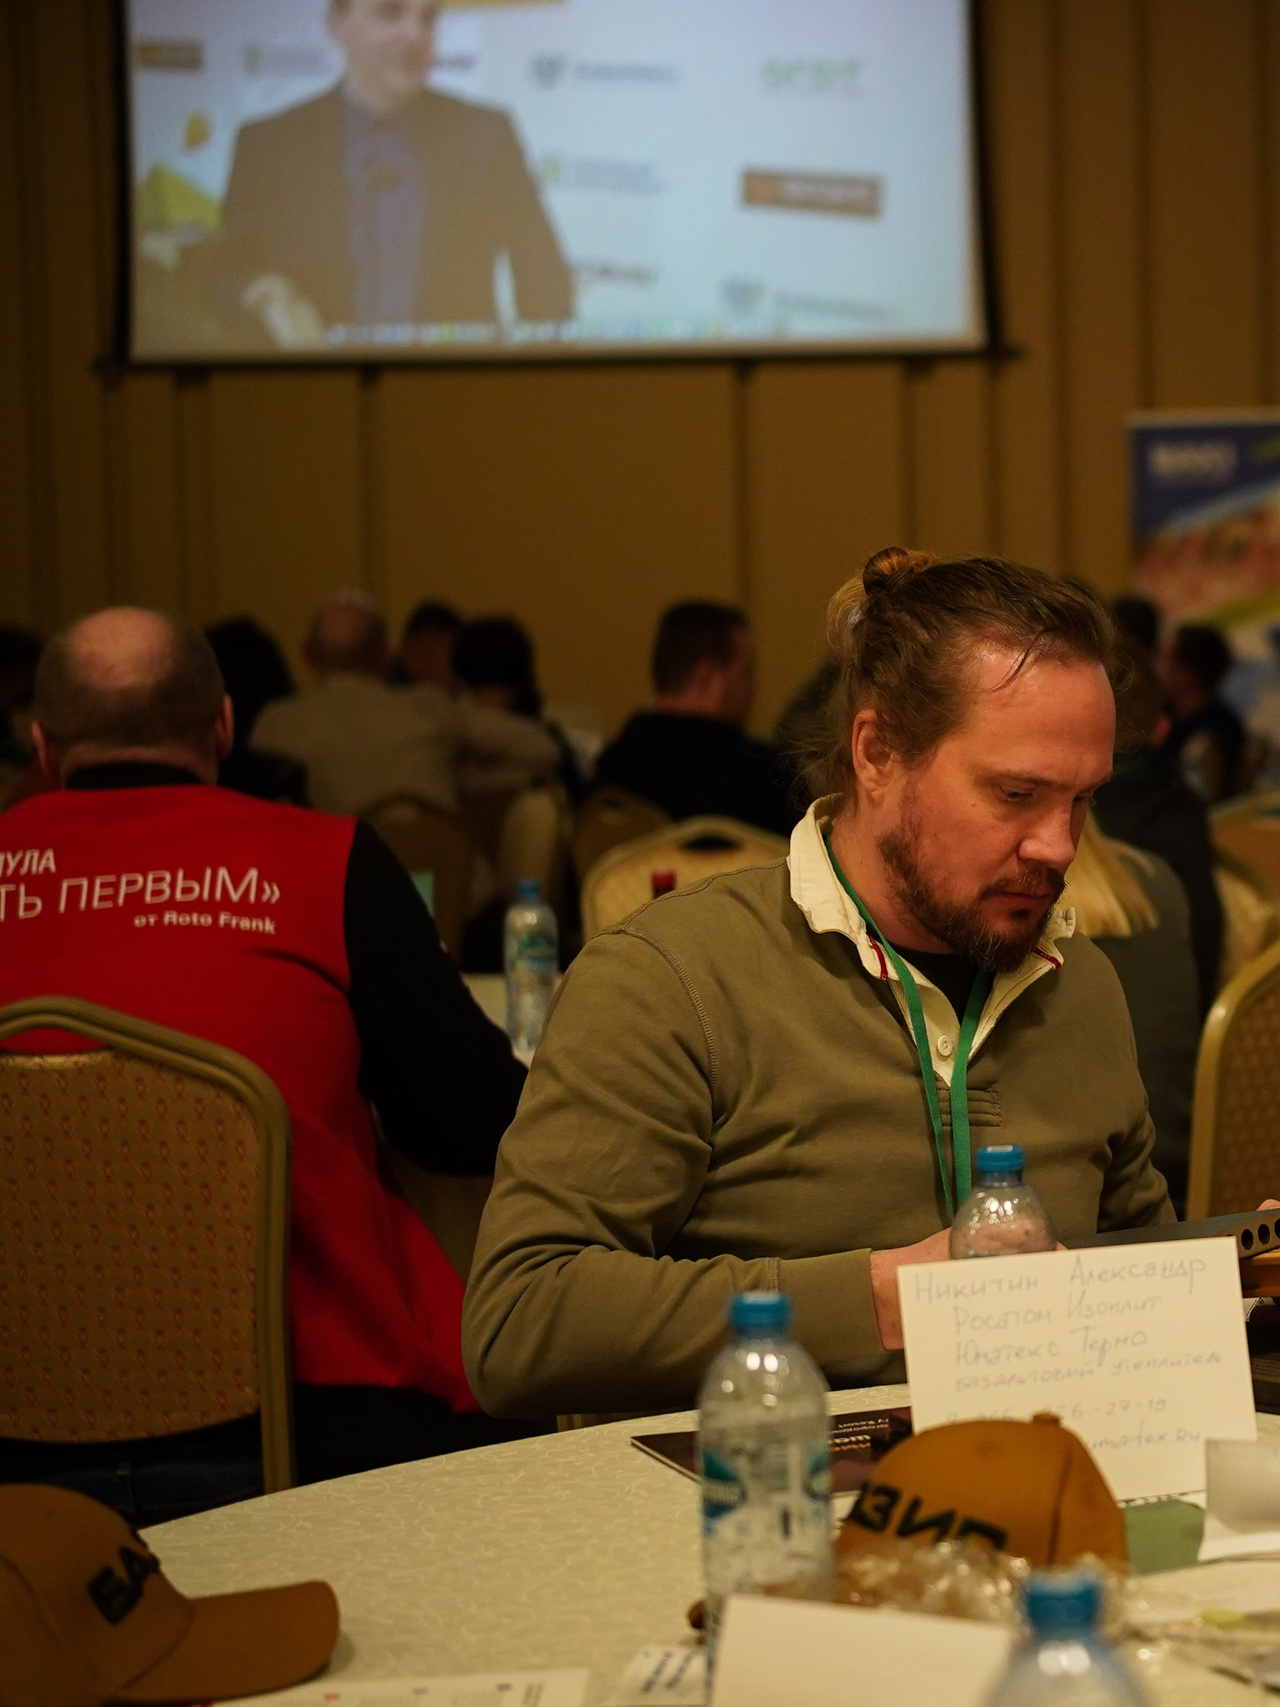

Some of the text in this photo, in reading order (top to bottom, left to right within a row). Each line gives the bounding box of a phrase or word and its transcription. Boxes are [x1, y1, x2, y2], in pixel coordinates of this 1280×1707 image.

[59, 866, 281, 914] ПЕРВЫМ»
[163, 910, 213, 927] Roto
[218, 911, 276, 935] Frank
[914, 1252, 1207, 1304] Никитин Александр
[1069, 1325, 1149, 1367] Термо
